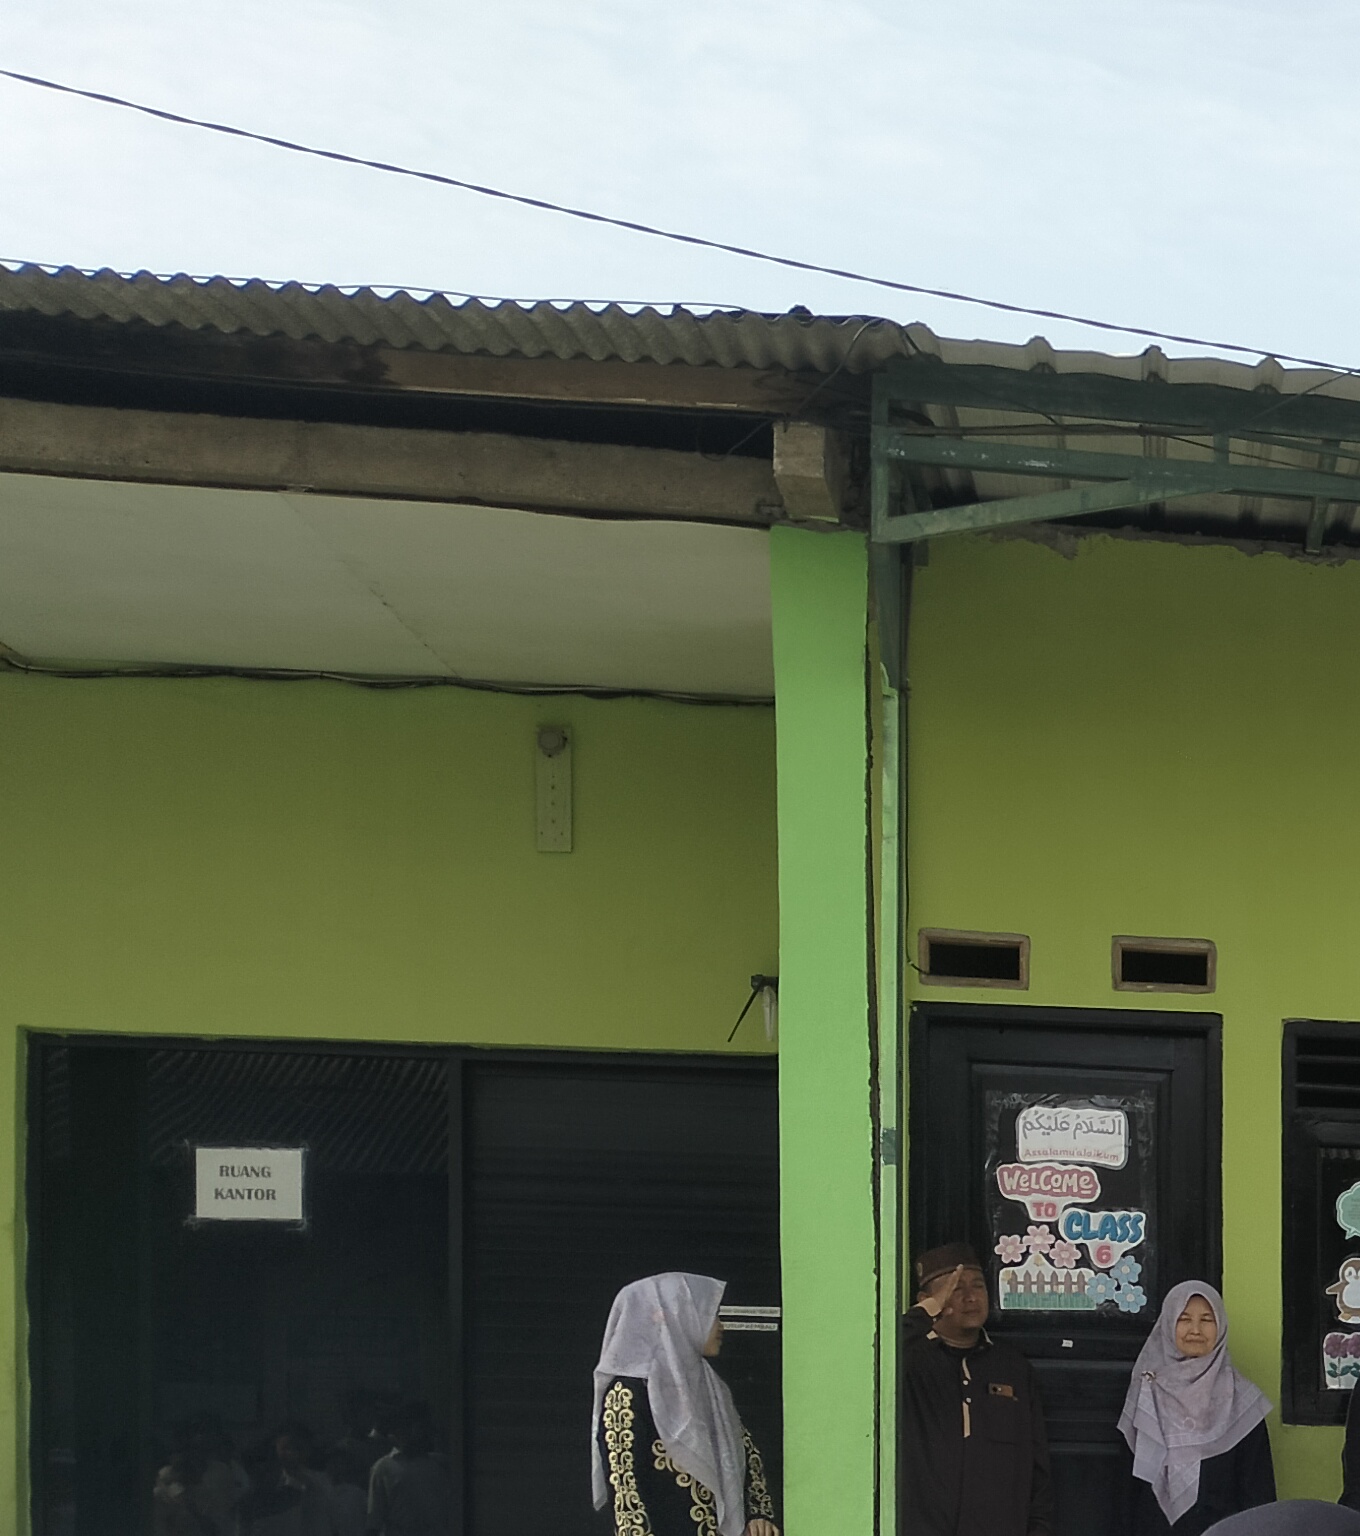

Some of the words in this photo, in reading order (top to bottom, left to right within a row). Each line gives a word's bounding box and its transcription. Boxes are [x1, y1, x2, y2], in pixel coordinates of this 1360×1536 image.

[219, 1165, 271, 1178] RUANG
[214, 1188, 276, 1200] KANTOR
[1032, 1202, 1057, 1217] TO
[1064, 1210, 1143, 1243] CLASS
[1096, 1245, 1112, 1264] 6
